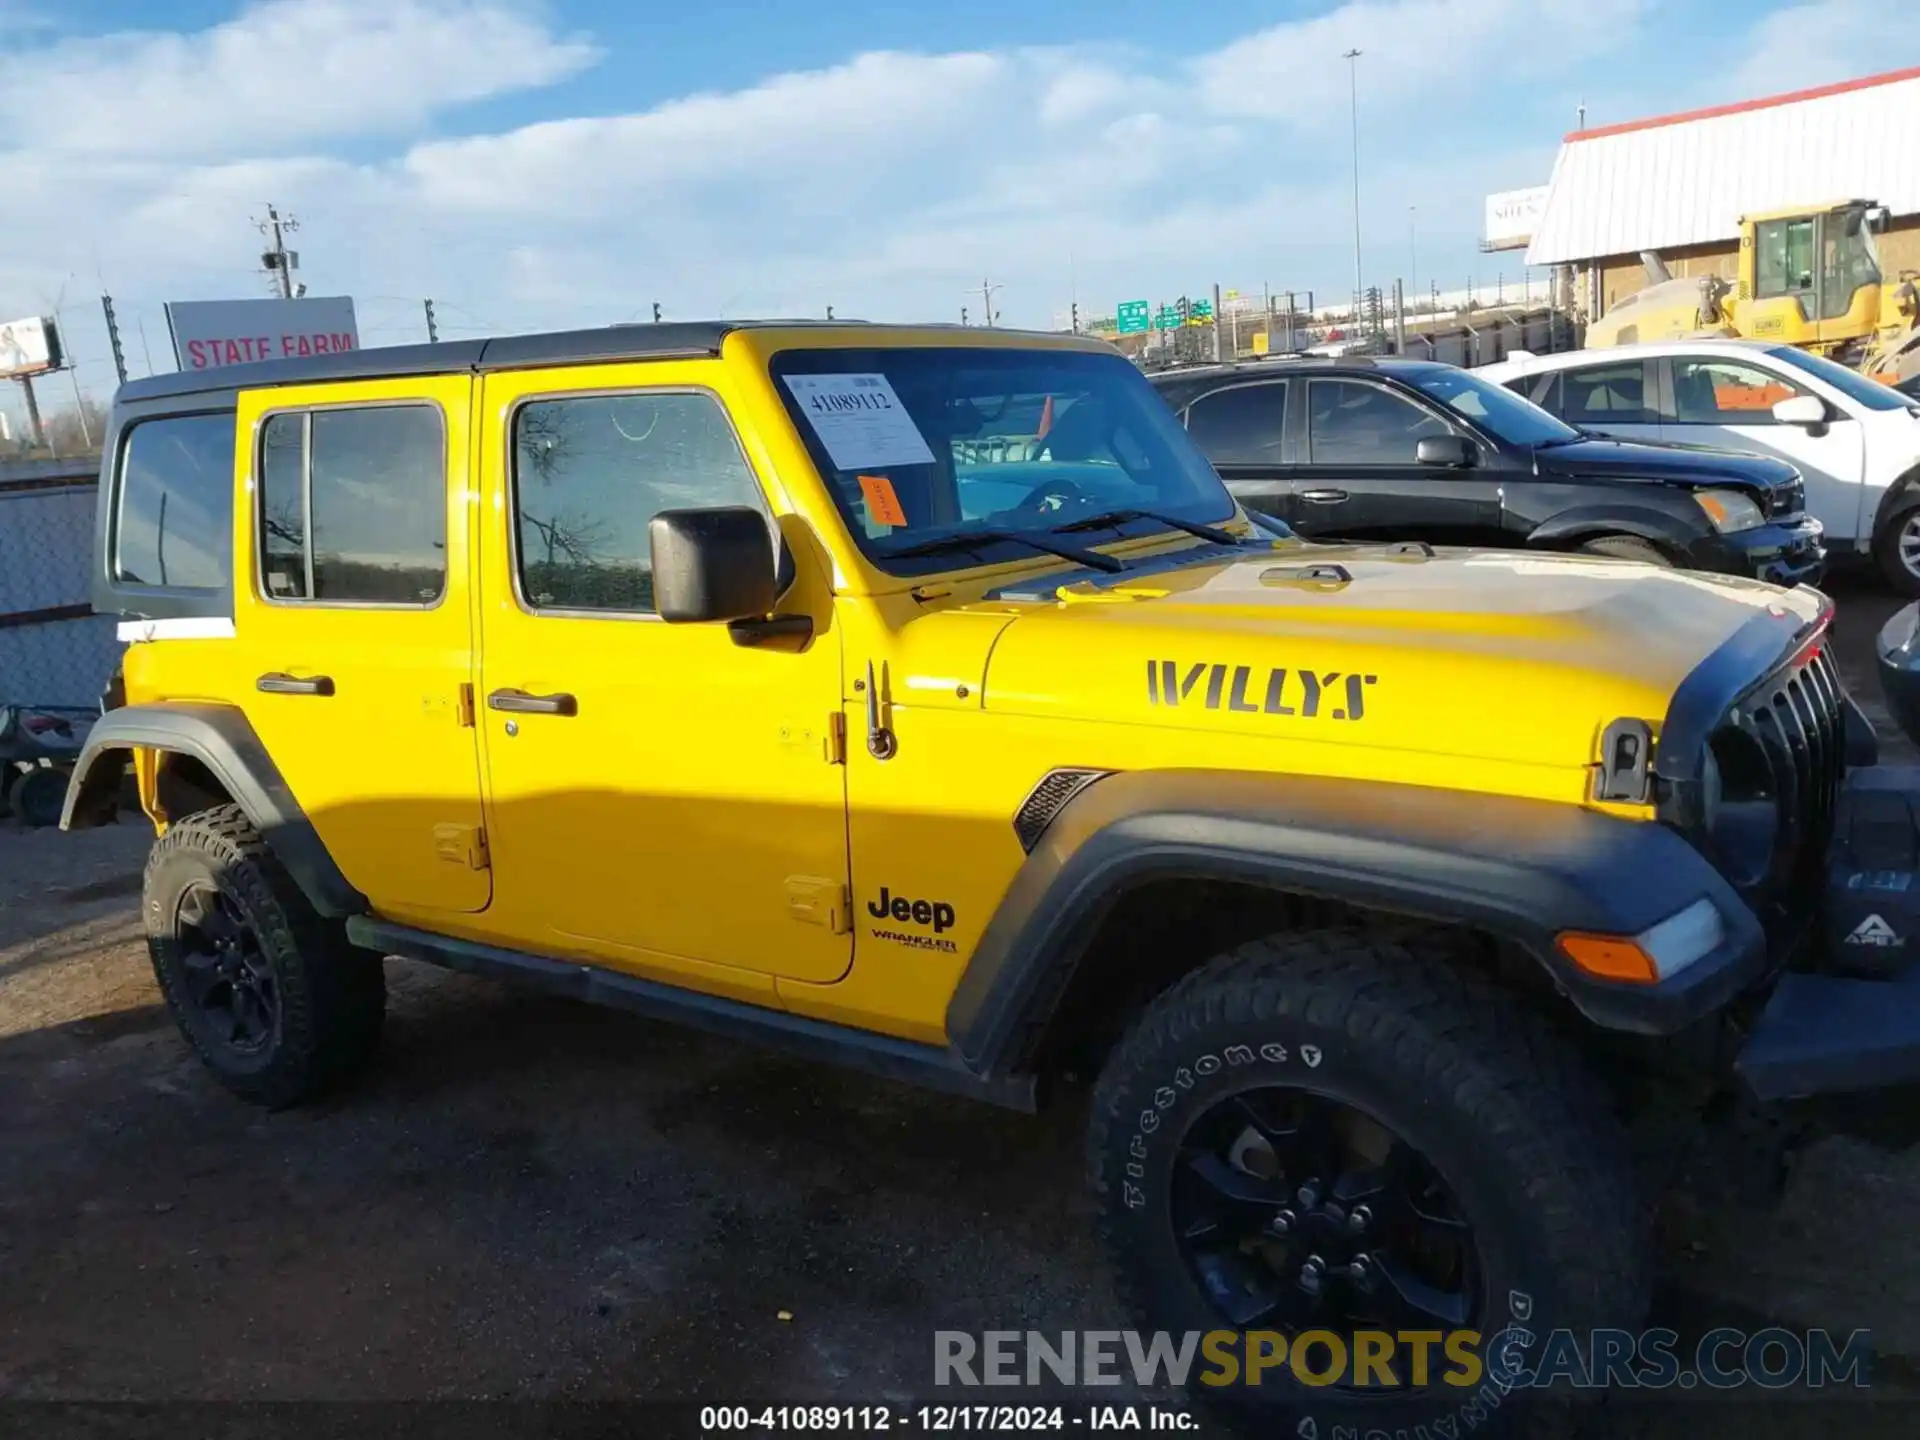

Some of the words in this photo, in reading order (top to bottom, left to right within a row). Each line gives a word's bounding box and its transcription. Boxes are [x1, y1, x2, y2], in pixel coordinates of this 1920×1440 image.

[188, 336, 272, 369] STATE
[281, 333, 352, 359] FARM
[811, 392, 892, 412] 41089112
[1147, 660, 1377, 721] WILLYS
[868, 887, 956, 934] Jeep
[872, 928, 959, 954] WRANGLER
